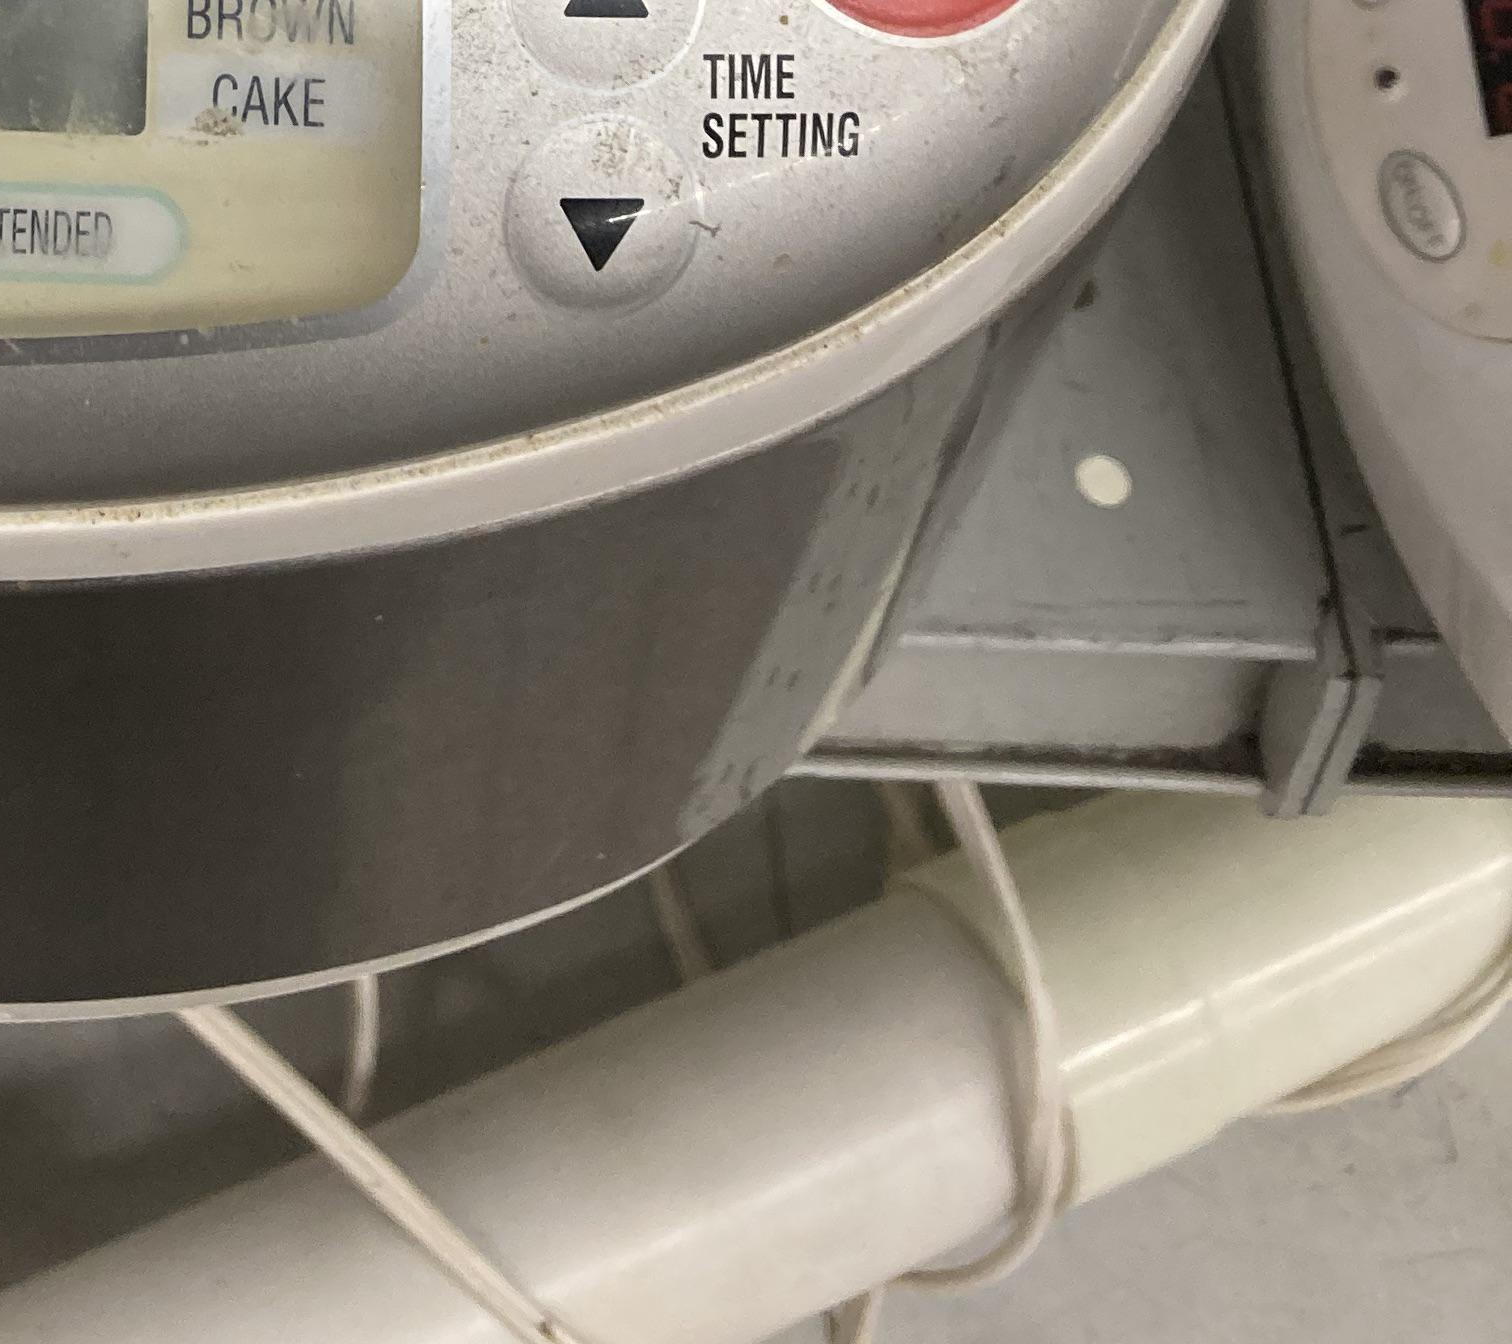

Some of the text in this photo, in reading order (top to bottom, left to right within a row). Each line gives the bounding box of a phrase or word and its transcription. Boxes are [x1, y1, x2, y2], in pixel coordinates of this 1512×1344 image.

[702, 53, 795, 100] TIME
[212, 73, 326, 128] CAKE
[702, 112, 861, 158] SETTING
